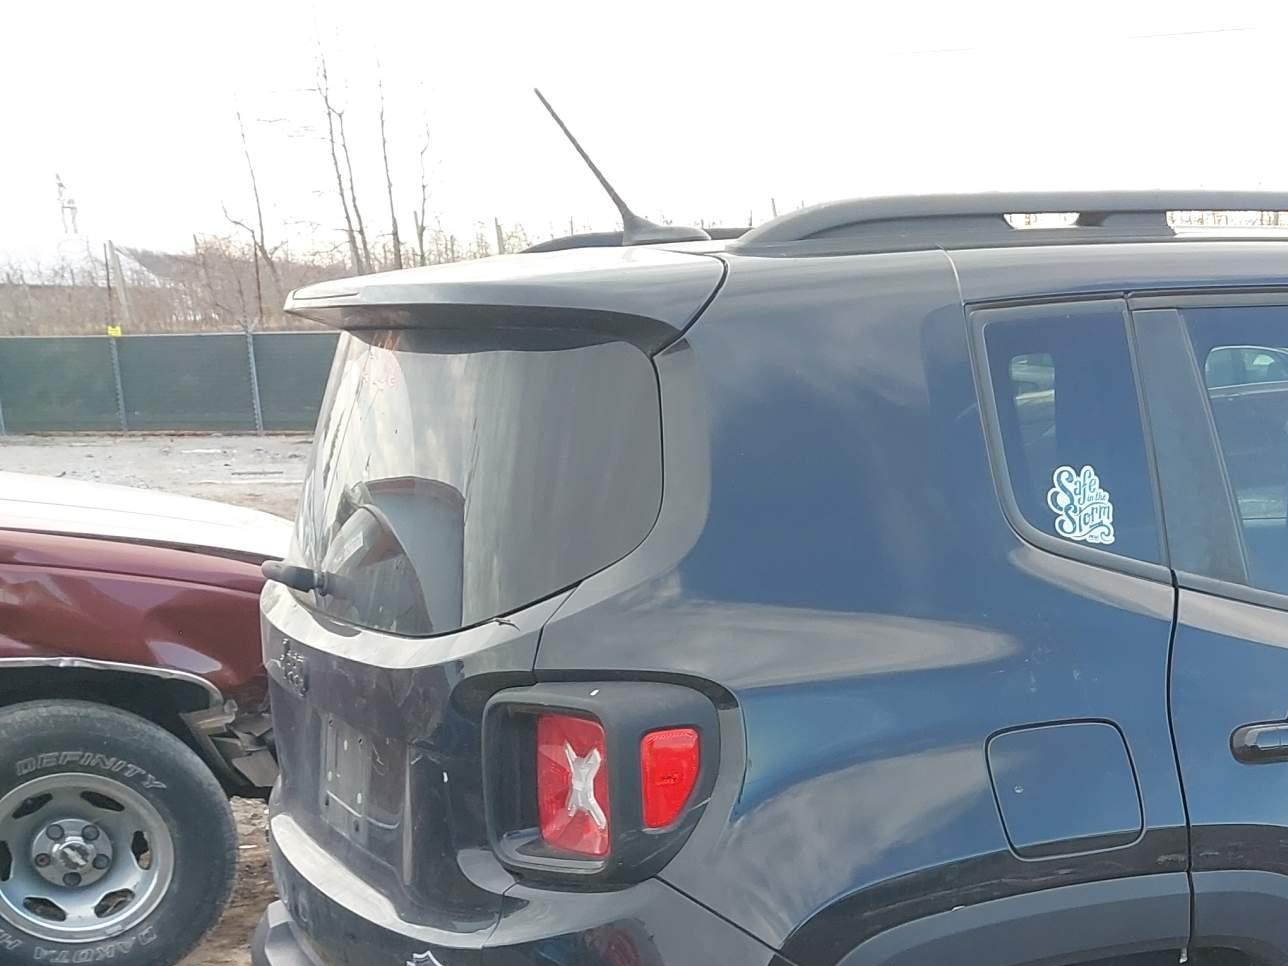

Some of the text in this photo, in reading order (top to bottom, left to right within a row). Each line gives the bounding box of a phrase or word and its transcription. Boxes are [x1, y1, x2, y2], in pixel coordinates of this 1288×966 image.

[1050, 468, 1098, 513] Safe
[1095, 491, 1107, 503] the
[1057, 504, 1110, 535] Storm
[16, 751, 168, 789] DEFINITY
[33, 926, 158, 964] DAKOTA
